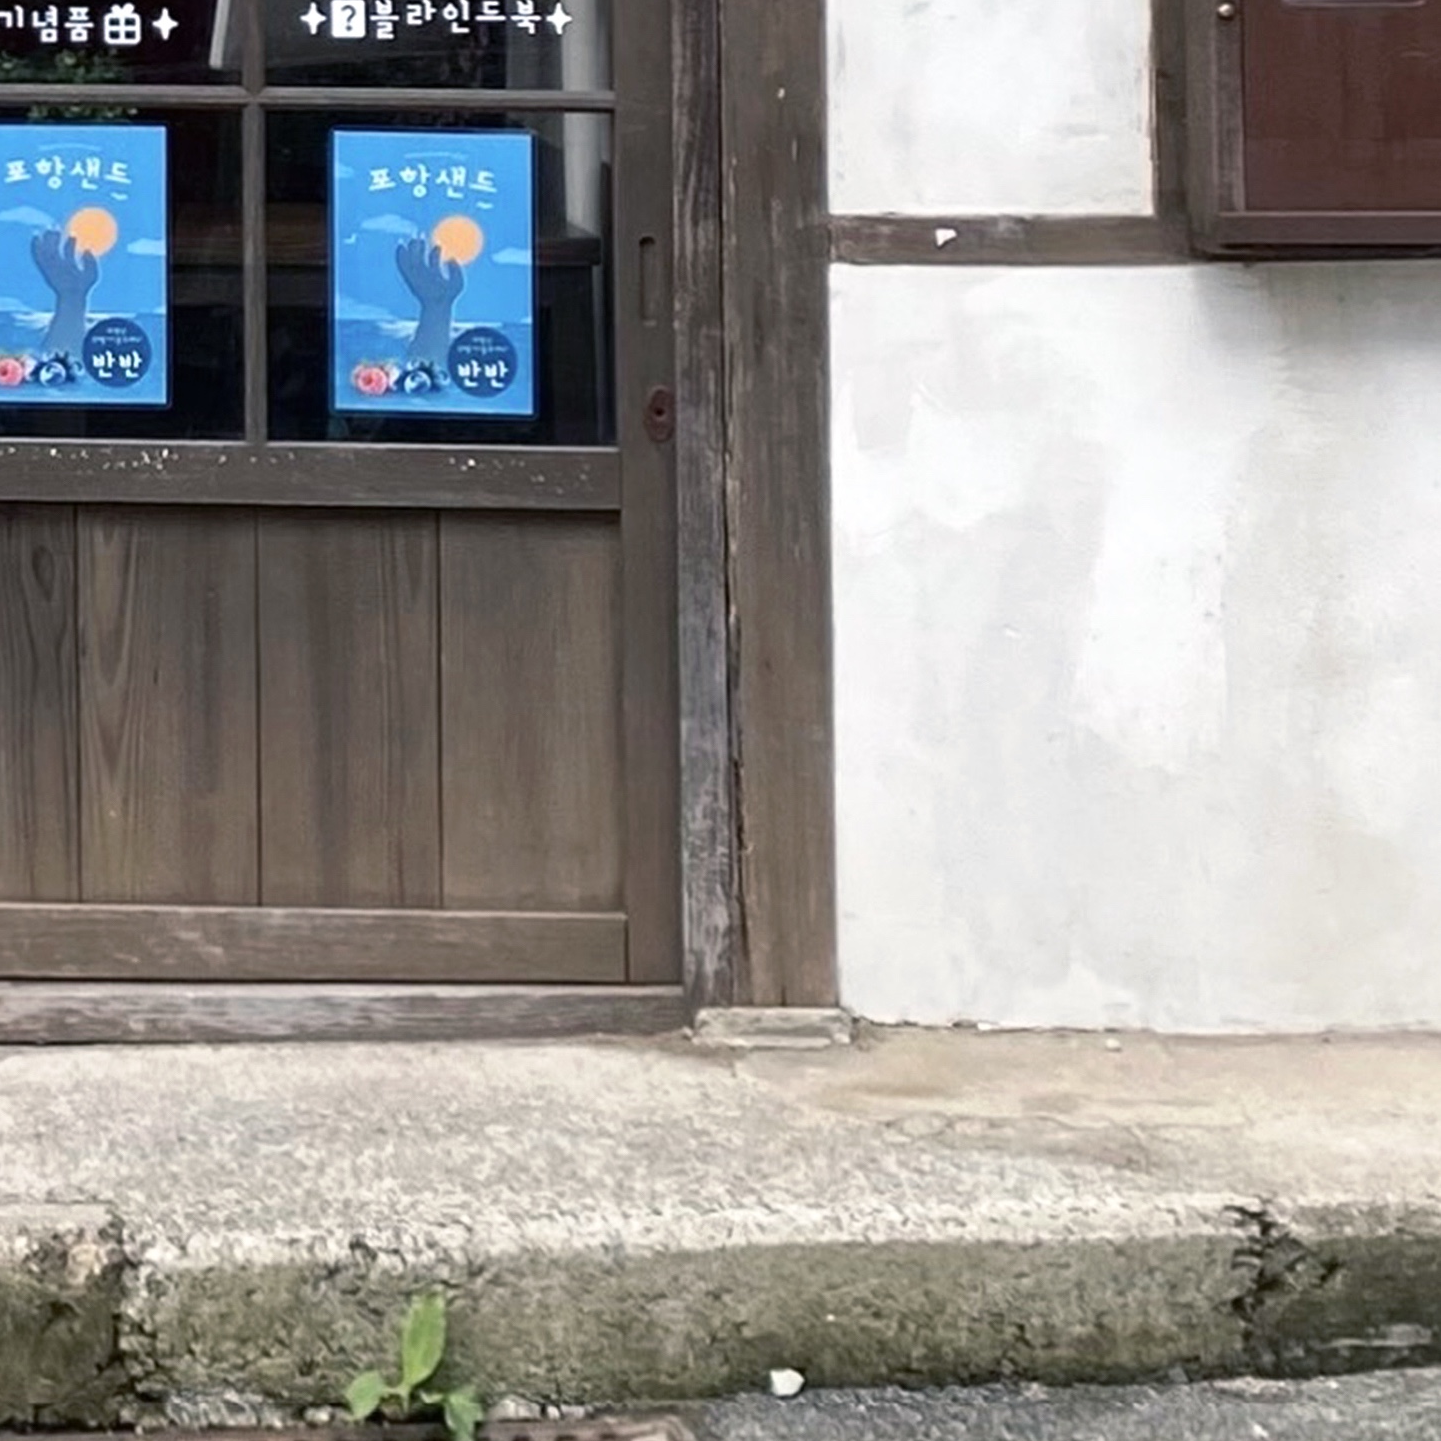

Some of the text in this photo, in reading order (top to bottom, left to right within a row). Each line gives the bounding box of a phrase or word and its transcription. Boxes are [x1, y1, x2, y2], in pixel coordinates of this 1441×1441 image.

[3, 155, 133, 190] 포항샌드
[368, 163, 498, 200] 포항샌드
[91, 349, 143, 379] 반반
[456, 358, 510, 394] 반반
